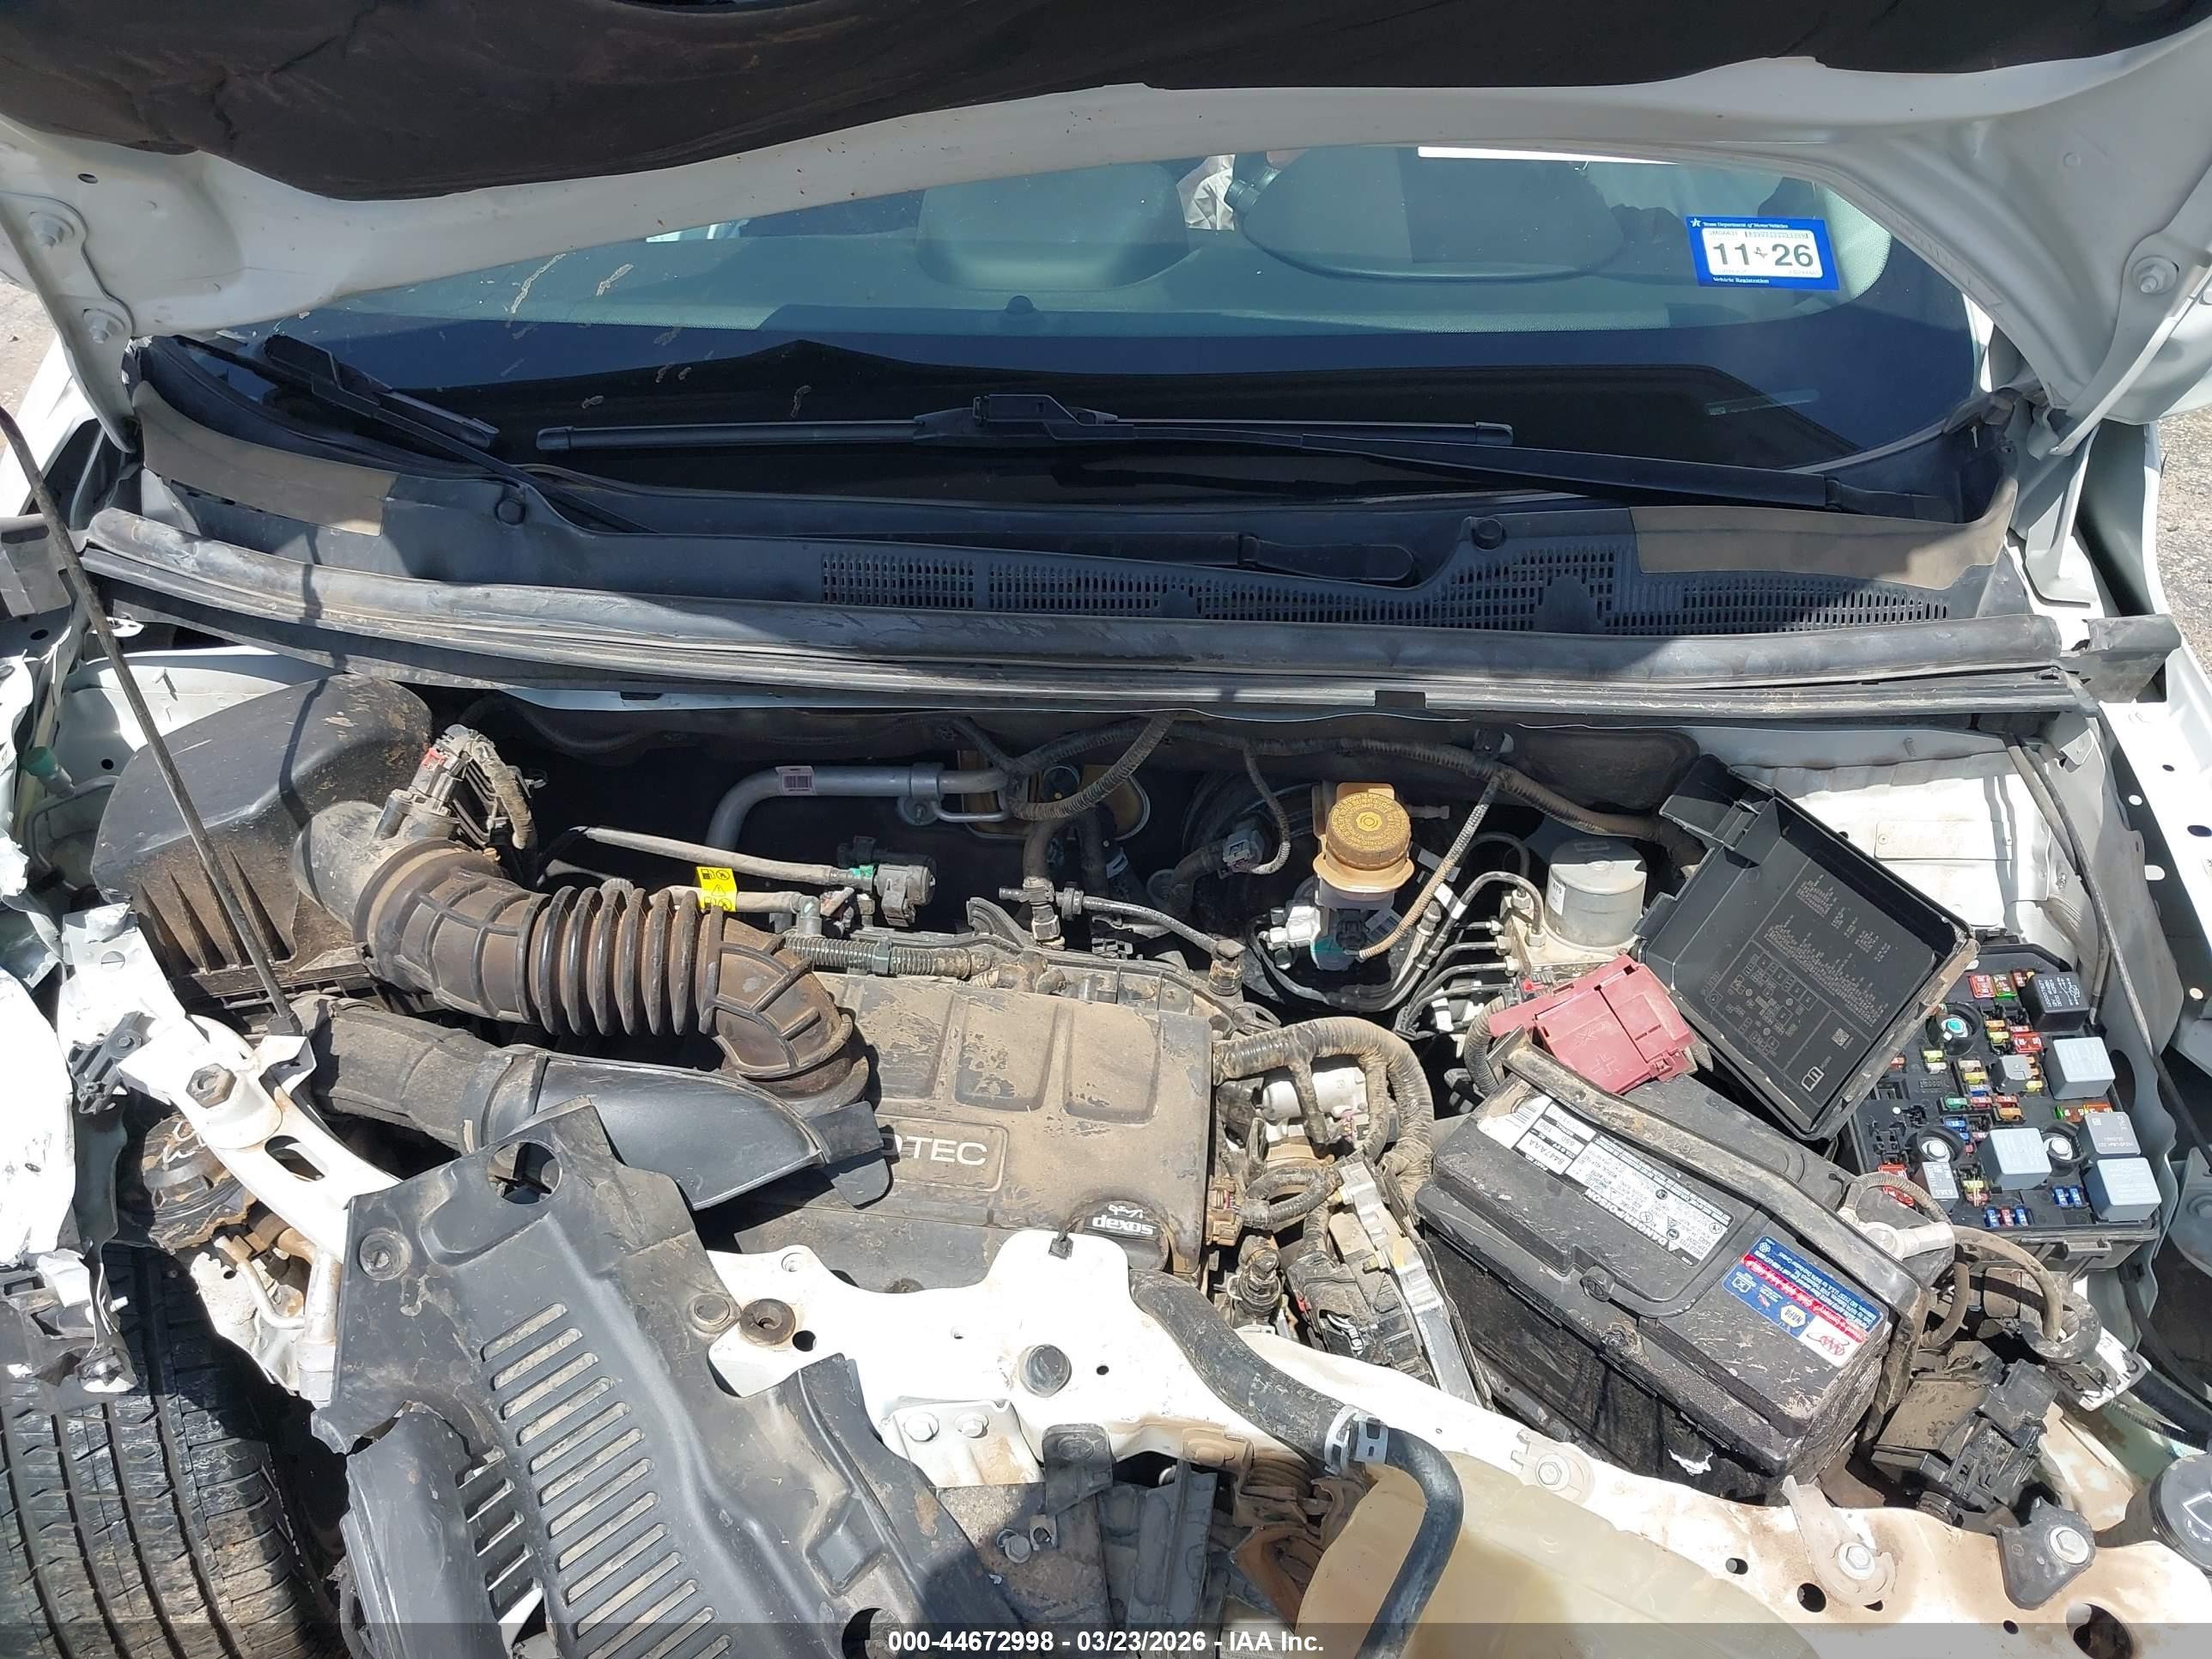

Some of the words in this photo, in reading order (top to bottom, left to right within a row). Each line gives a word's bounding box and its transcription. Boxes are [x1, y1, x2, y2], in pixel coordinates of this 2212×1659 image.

[1713, 243, 1750, 265] 11
[1771, 243, 1814, 267] 26
[1532, 1158, 1548, 1171] PART
[1091, 1213, 1157, 1236] dexos
[1582, 1187, 1670, 1246] DANGER/POISON
[1784, 1308, 1803, 1324] NAPA
[1820, 1337, 1843, 1355] AAA
